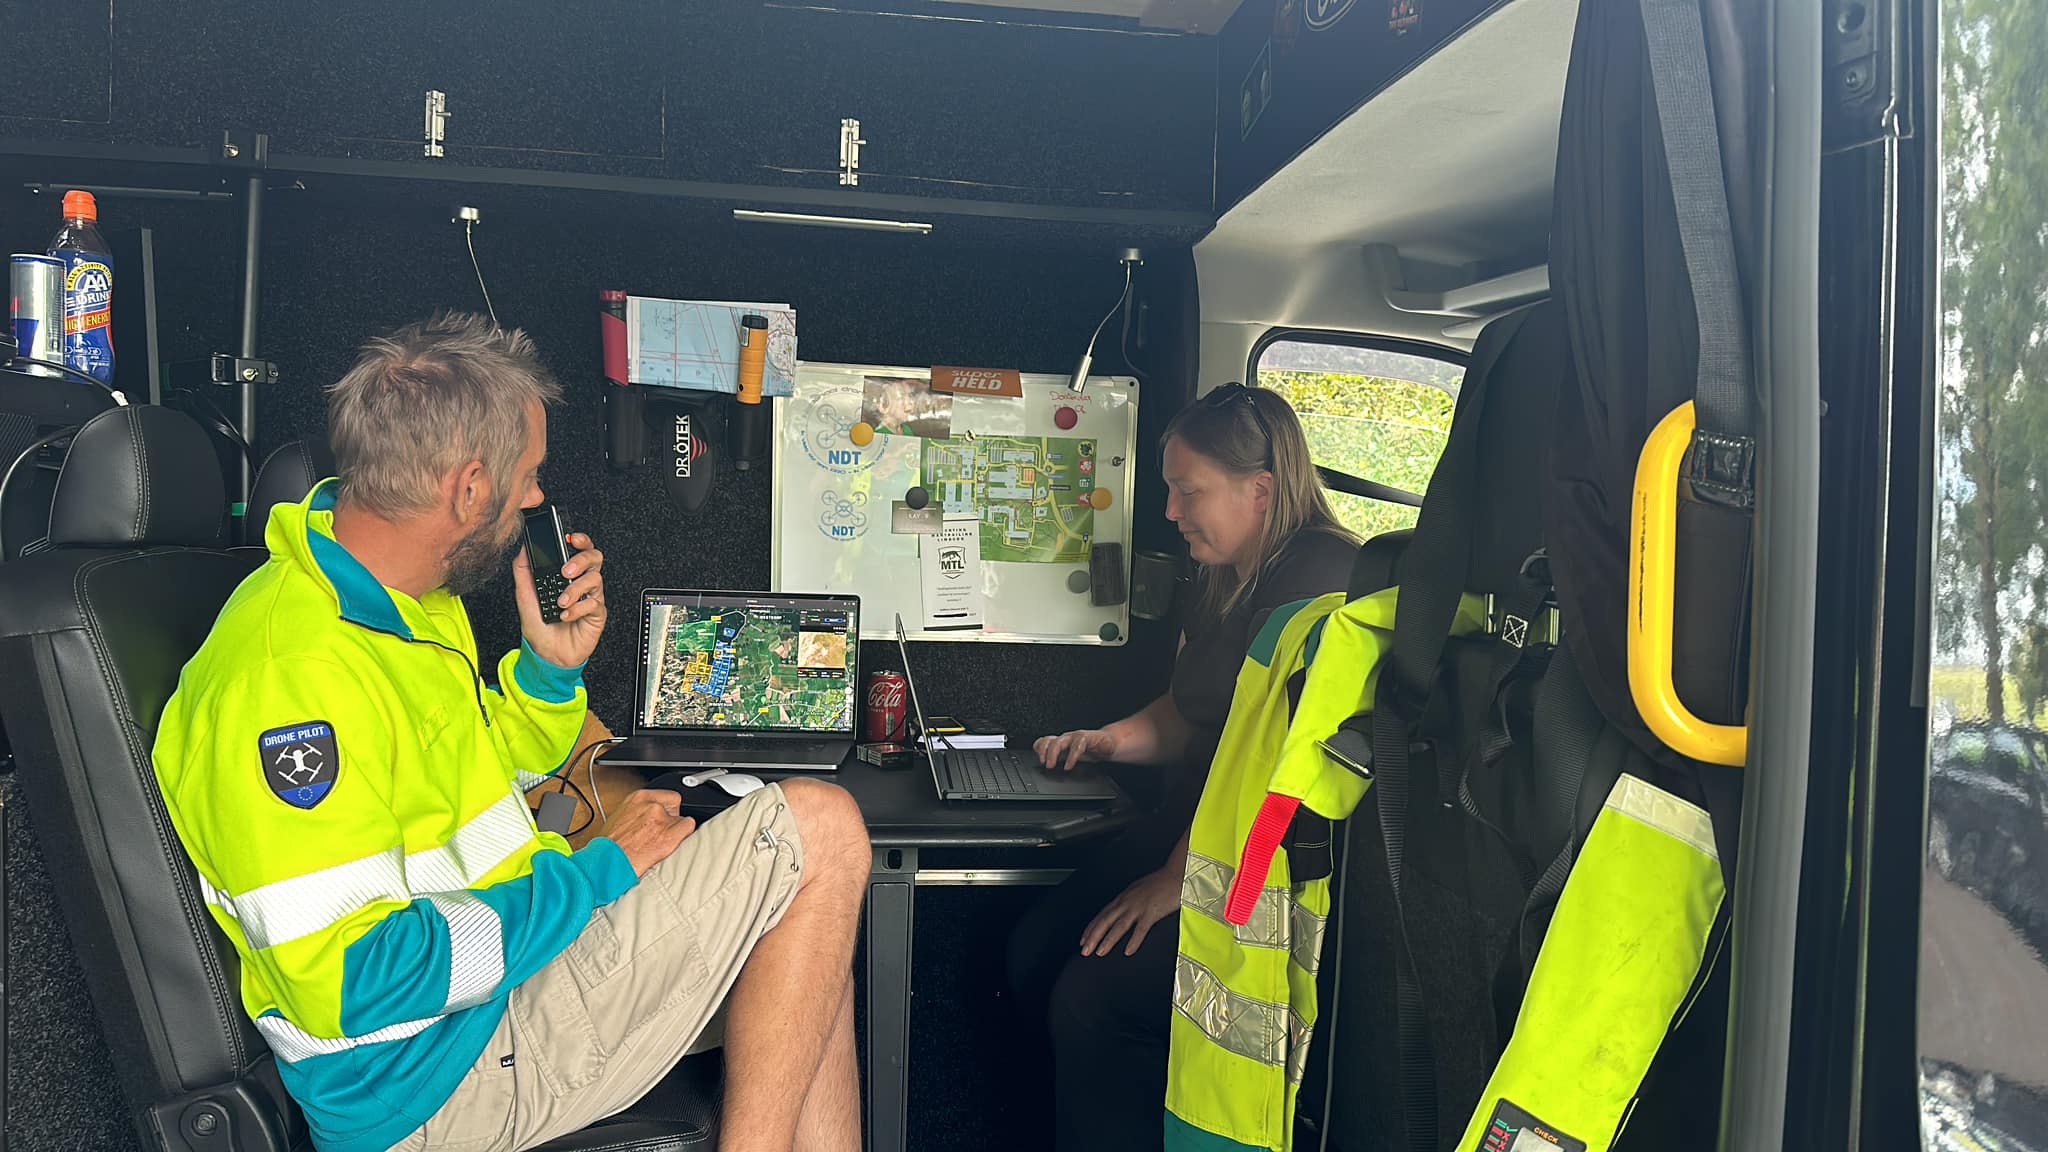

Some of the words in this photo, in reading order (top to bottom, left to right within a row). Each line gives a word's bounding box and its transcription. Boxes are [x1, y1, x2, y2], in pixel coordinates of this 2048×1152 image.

[82, 273, 109, 292] AA
[952, 369, 1002, 380] super
[952, 376, 1002, 390] HELD
[673, 414, 690, 478] DR.ÖTEK
[828, 450, 862, 465] NDT
[831, 526, 855, 536] NDT
[941, 560, 965, 570] MTL
[868, 681, 904, 708] Cola
[264, 731, 296, 747] DRONE
[297, 726, 324, 740] PILOT
[1533, 1126, 1559, 1144] CHECK
